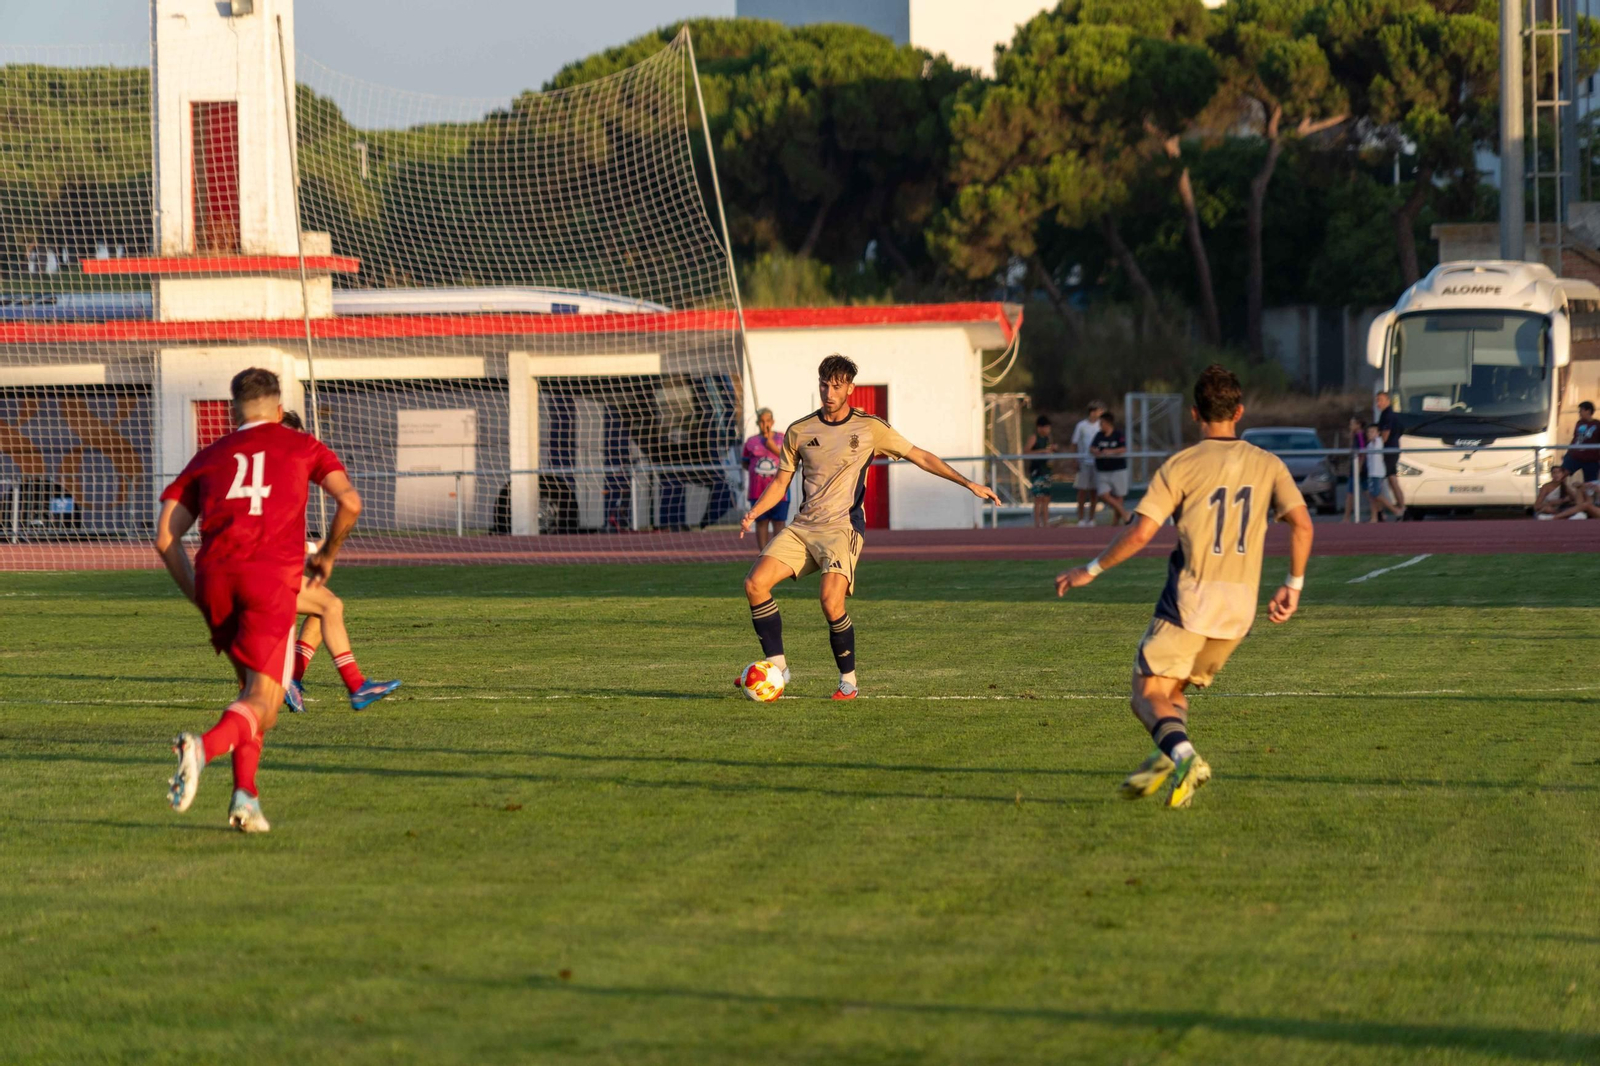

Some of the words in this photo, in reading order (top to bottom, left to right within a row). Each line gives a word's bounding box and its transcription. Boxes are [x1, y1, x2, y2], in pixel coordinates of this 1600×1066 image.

[1442, 285, 1502, 296] ALOMPE
[225, 451, 272, 516] 4
[1208, 485, 1253, 556] 11
